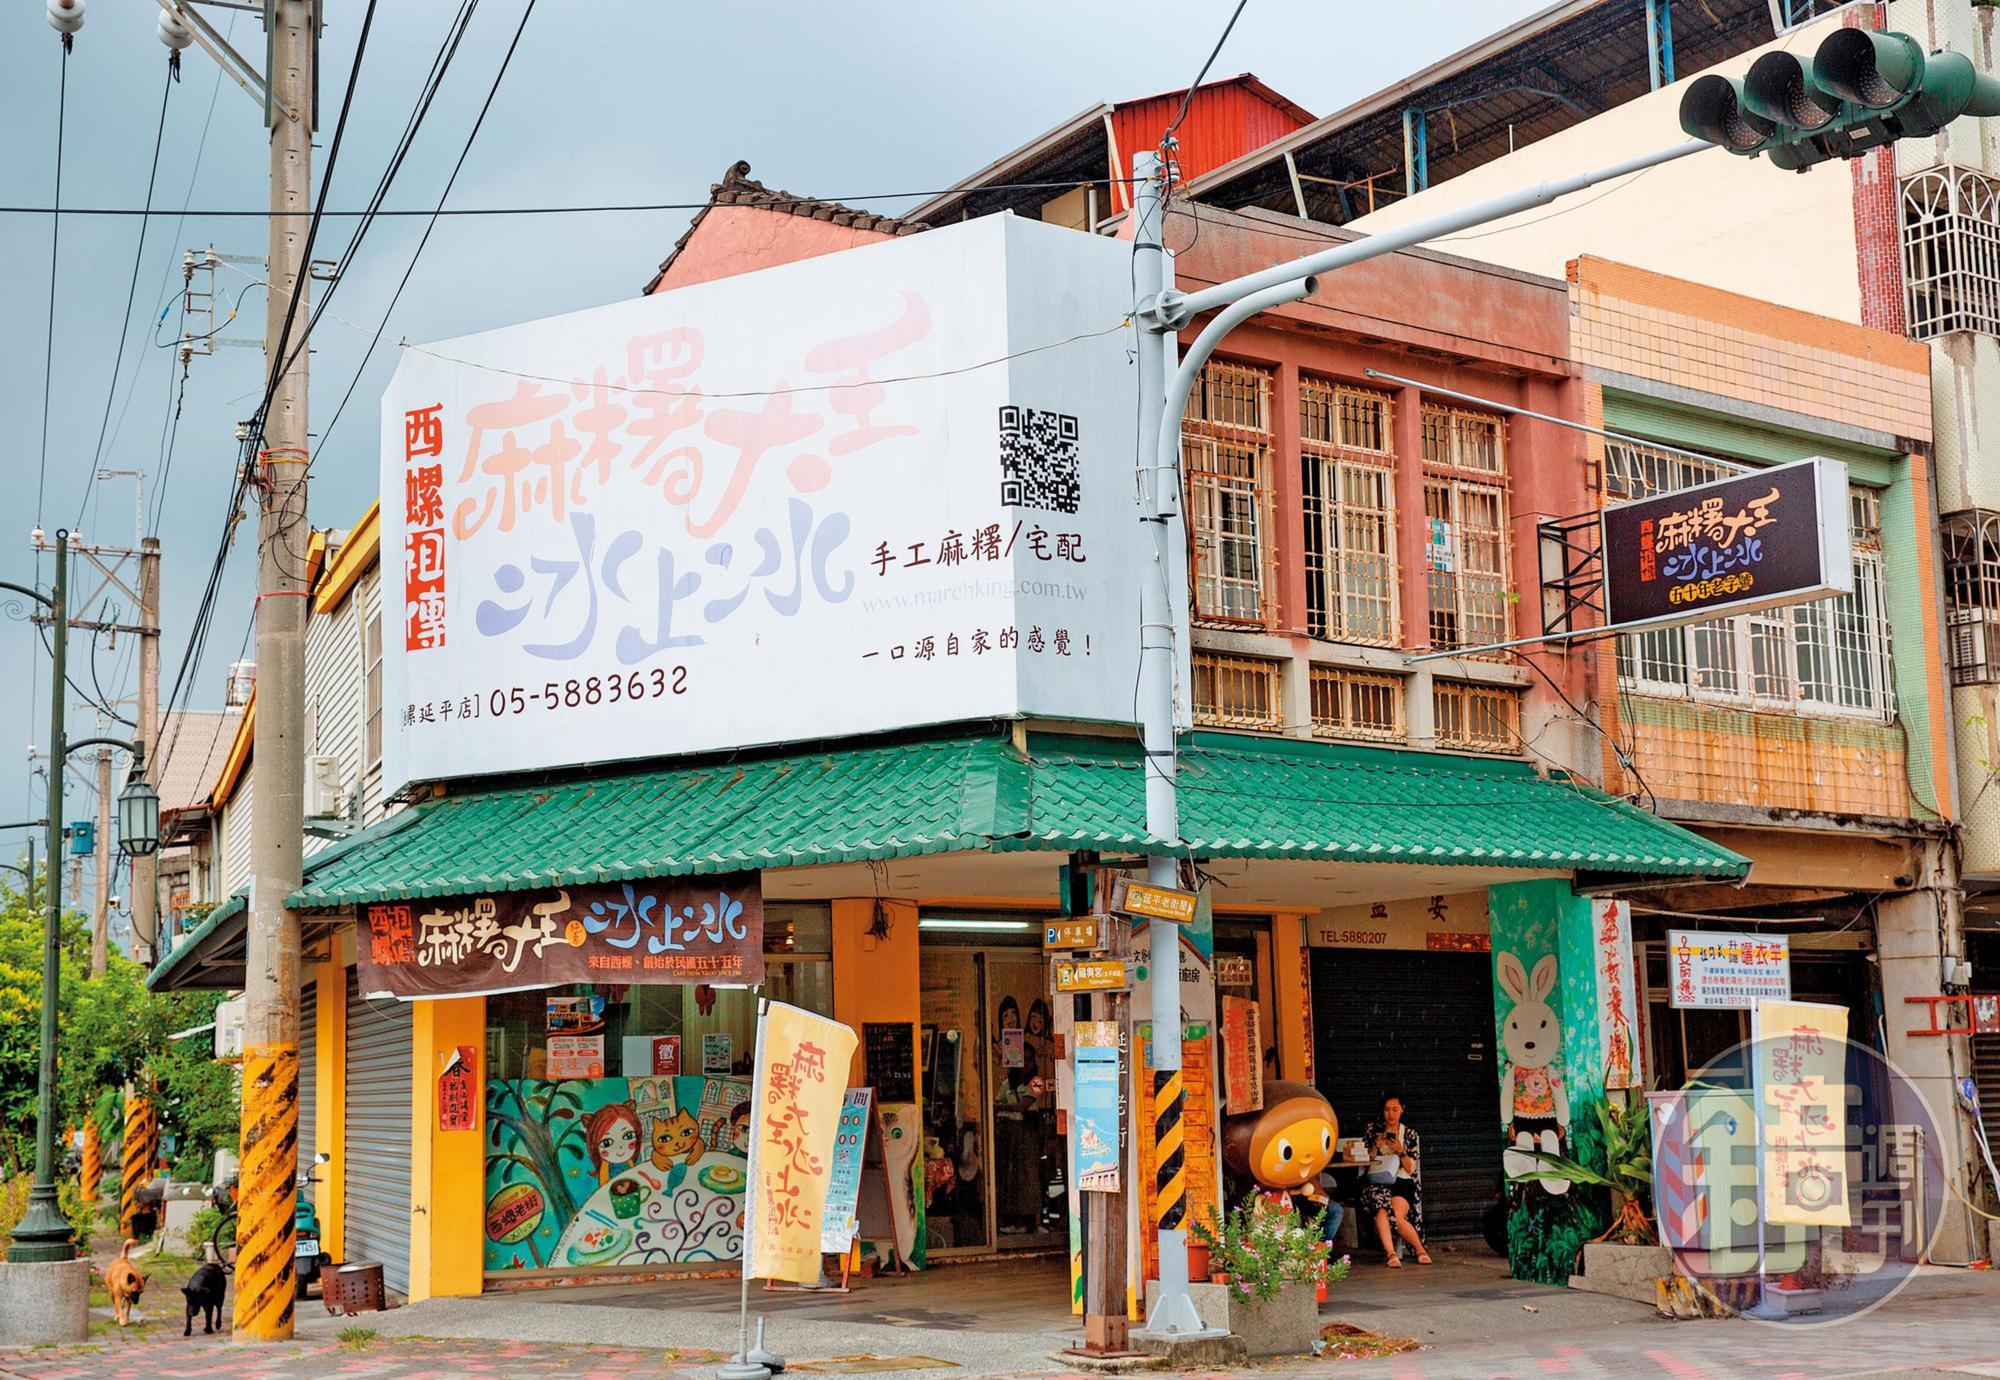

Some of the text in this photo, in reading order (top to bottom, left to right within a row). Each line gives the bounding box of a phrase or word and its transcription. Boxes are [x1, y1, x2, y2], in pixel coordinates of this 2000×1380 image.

[452, 290, 932, 541] 麻糬大王
[405, 402, 445, 653] 西螺祖傳
[870, 520, 1087, 577] 手工麻糬/宅配
[1655, 487, 1781, 553] 麻糬大王
[475, 497, 857, 667] 冰上冰
[1663, 537, 1763, 581] 冰上冰
[862, 578, 1088, 613] www.marchking.com.tw
[490, 665, 688, 717] 05-5883632
[418, 889, 570, 972] 麻糬大王
[585, 883, 747, 954] 冰上冰
[1320, 930, 1387, 945] TEL:5880207
